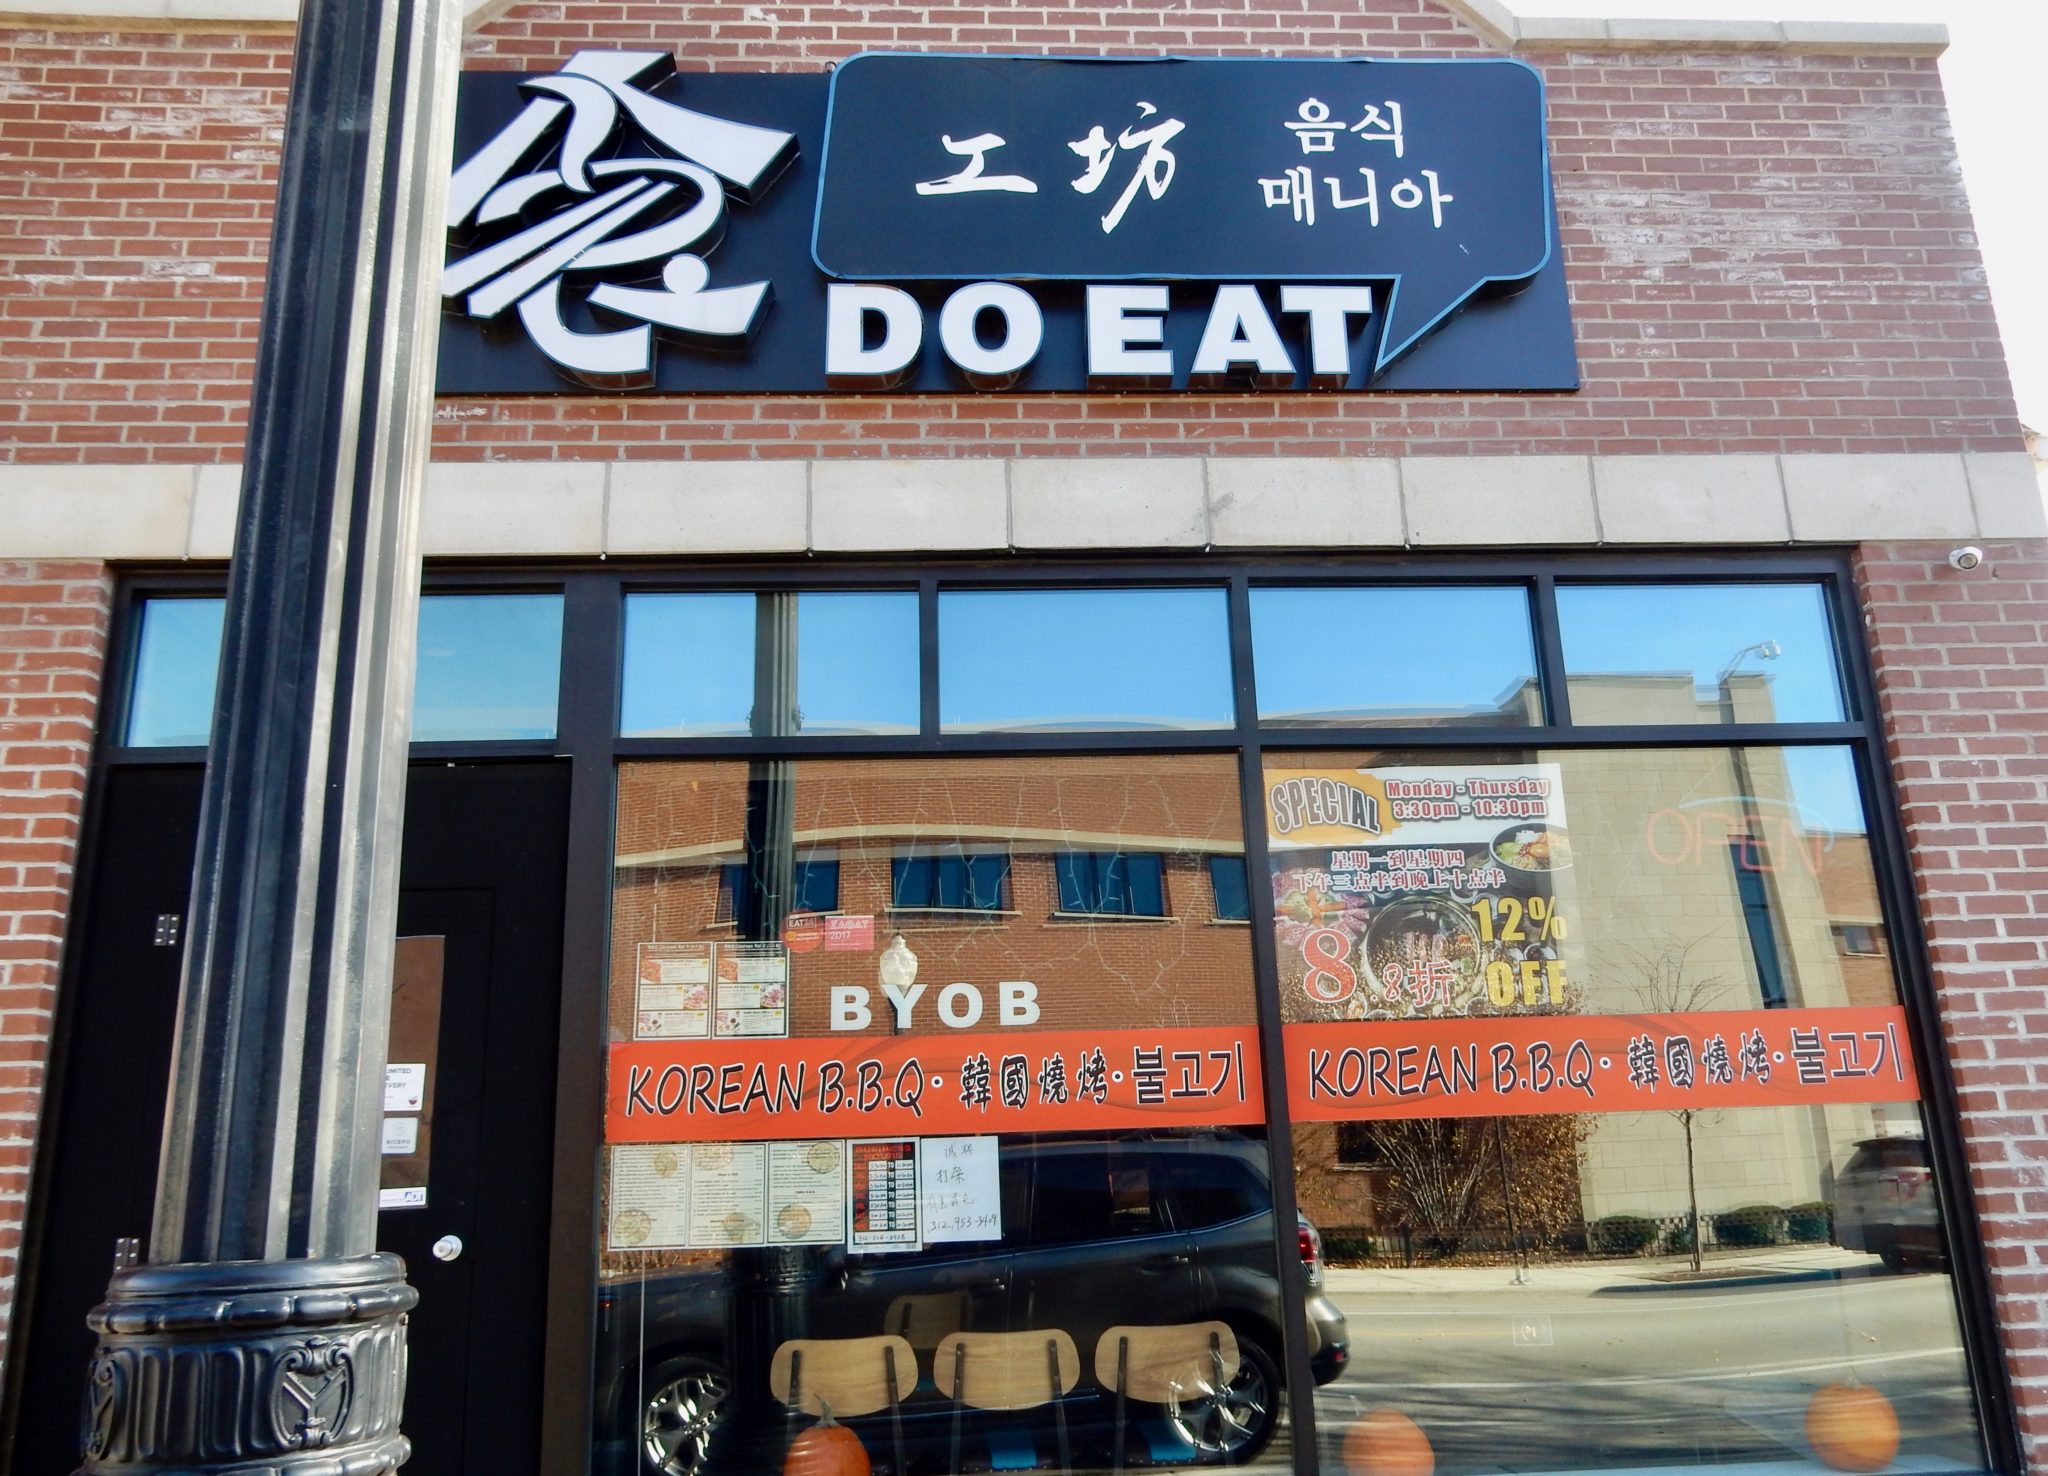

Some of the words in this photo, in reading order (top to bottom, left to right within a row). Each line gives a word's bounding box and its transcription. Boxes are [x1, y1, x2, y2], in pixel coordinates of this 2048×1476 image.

[1283, 97, 1404, 159] 음식
[1257, 165, 1454, 229] 매니아
[825, 281, 1045, 376] DO
[1085, 284, 1373, 376] EAT
[1271, 777, 1382, 835] SPECIAL
[1387, 780, 1453, 799] Monday
[1468, 778, 1549, 796] Thursday
[1394, 801, 1460, 819] 3:30pm
[1474, 799, 1548, 817] 10:30pm
[1331, 849, 1466, 871] 星期一到星期四
[1647, 806, 1823, 874] OPEN
[830, 919, 869, 929] ZAGAT
[830, 930, 851, 940] 2017
[1470, 896, 1568, 942] 12%
[829, 980, 1041, 1031] BYOB
[1485, 959, 1568, 1008] OFF
[625, 1060, 807, 1117] KOREAN
[1130, 1039, 1248, 1106] 불고기
[1308, 1042, 1479, 1100] KOREAN
[1789, 1021, 1906, 1085] 불고기
[856, 1144, 912, 1153] BUSINESS
